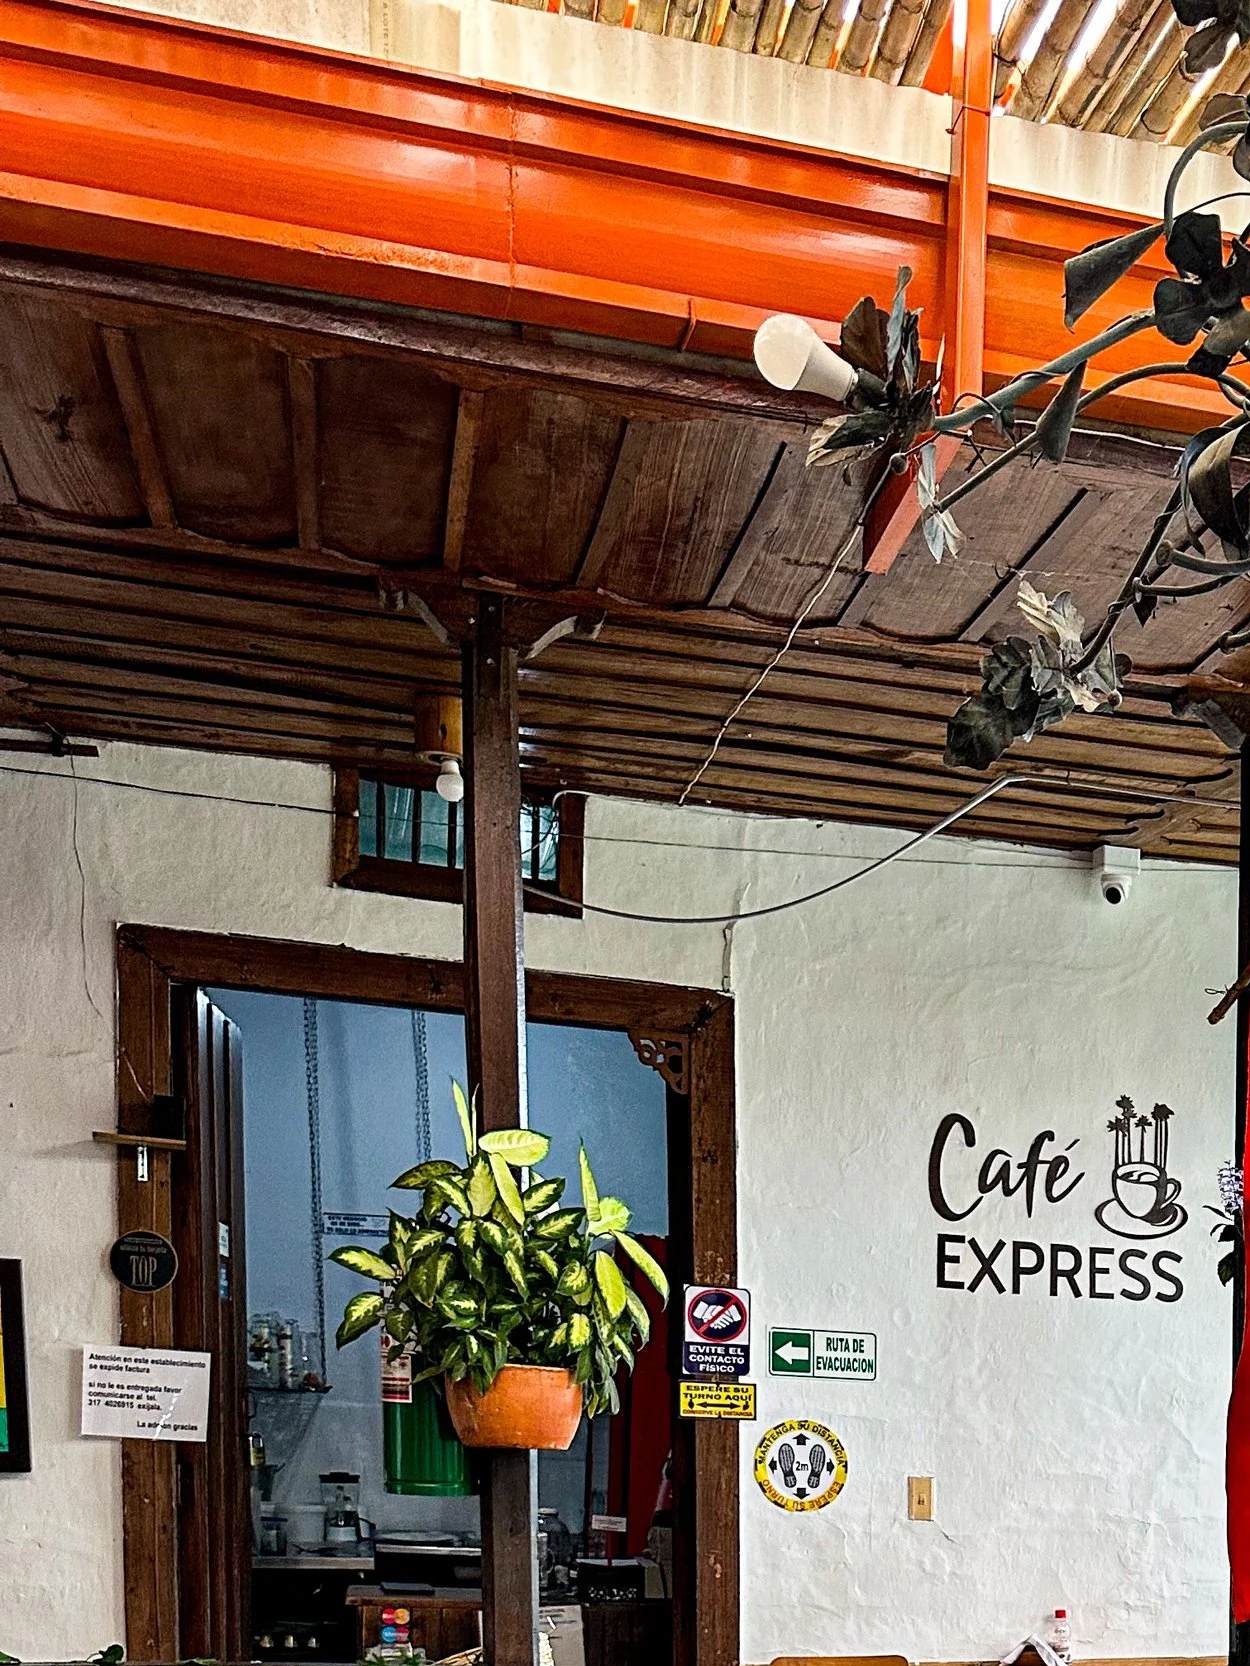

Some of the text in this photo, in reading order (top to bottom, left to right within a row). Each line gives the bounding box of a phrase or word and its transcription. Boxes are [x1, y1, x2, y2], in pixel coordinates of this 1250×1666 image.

[929, 1113, 1085, 1221] Café
[130, 1255, 157, 1287] TOP
[936, 1233, 1184, 1303] EXPRESS
[689, 1345, 744, 1355] EVITE EL
[826, 1337, 864, 1353] RUTA DE
[89, 1353, 121, 1362] Atención
[150, 1358, 206, 1368] establecimiento
[688, 1354, 744, 1364] CONTACTO
[125, 1365, 150, 1373] factura
[699, 1363, 735, 1372] FÍSICO
[127, 1384, 162, 1393] entregada
[88, 1391, 134, 1399] comunicarse
[758, 1422, 844, 1465] MANTENGA SU DISTANCIA
[796, 1461, 808, 1471] 2m
[763, 1480, 841, 1510] ESPERE SU TURNO
